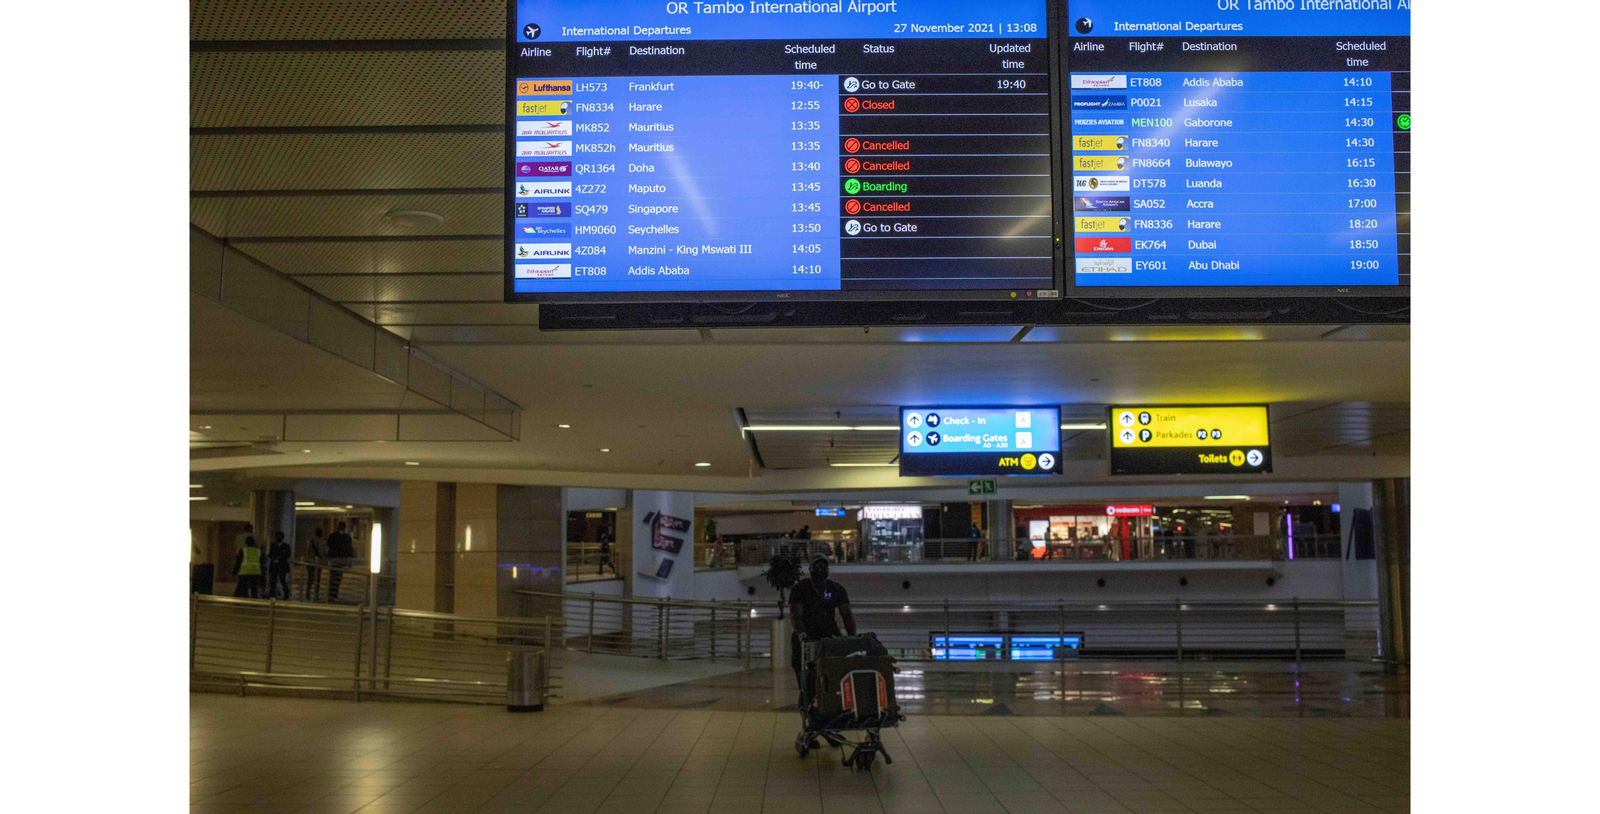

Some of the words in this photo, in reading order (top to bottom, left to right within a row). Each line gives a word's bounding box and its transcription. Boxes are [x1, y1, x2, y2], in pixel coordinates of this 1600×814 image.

[667, 2, 688, 14] OR
[694, 2, 744, 14] Tambo
[750, 2, 842, 13] International
[847, 1, 897, 15] Airport
[1217, 0, 1240, 10] OR
[1246, 0, 1295, 10] Tambo
[1300, 0, 1392, 10] International
[562, 26, 630, 36] International
[633, 25, 691, 36] Departures
[894, 24, 907, 33] 27
[911, 24, 965, 33] November
[968, 24, 994, 33] 2021
[1007, 24, 1037, 33] 13:08
[1114, 22, 1182, 31] International
[1185, 22, 1243, 32] Departures
[785, 44, 835, 54] Scheduled
[863, 44, 894, 53] Status
[989, 44, 1031, 54] Updated
[1074, 42, 1104, 51] Airline
[1129, 42, 1164, 52] Flight#
[1182, 42, 1237, 51] Destination
[1336, 41, 1386, 50] Scheduled
[521, 47, 551, 57] Airline
[576, 46, 611, 58] Flight#
[629, 46, 685, 55] Destination
[795, 60, 817, 70] time
[1002, 60, 1024, 68] time
[1347, 58, 1369, 66] time
[629, 81, 675, 91] Frankfurt
[791, 81, 824, 90] 19:40-
[862, 80, 876, 90] Go
[878, 80, 889, 89] to
[892, 80, 915, 89] Gate
[997, 80, 1026, 89] 19:40
[1130, 78, 1162, 87] ET808
[1182, 77, 1210, 87] Addis
[1212, 77, 1243, 87] Ababa
[1344, 78, 1372, 87] 14:10
[534, 84, 571, 92] Lufthansa
[576, 82, 608, 92] LH573
[576, 102, 614, 112] FN8334
[629, 102, 662, 112] Harare
[791, 101, 820, 110] 12:55
[862, 100, 895, 110] Closed
[1131, 98, 1161, 107] P0021
[1183, 98, 1217, 107] Lusaka
[1344, 98, 1373, 107] 14:15
[522, 103, 547, 115] fastjet
[629, 122, 674, 132] Mauritius
[791, 121, 820, 130] 13:35
[1132, 118, 1172, 127] MEN100
[1184, 118, 1233, 127] Gaborone
[1345, 118, 1373, 127] 14:30
[576, 123, 610, 132] MK852
[629, 142, 674, 152] Mauritius
[791, 142, 820, 151] 13:35
[862, 141, 910, 150] Cancelled
[1078, 137, 1103, 149] fastjet
[1132, 138, 1170, 148] FN8340
[1185, 138, 1218, 147] Harare
[1346, 138, 1375, 147] 14:30
[576, 143, 616, 153] MK852h
[791, 162, 820, 171] 13:40
[863, 161, 910, 171] Cancelled
[1079, 158, 1104, 170] fastjet
[1133, 159, 1171, 168] FN8664
[1185, 158, 1233, 170] Bulawayo
[1347, 159, 1375, 167] 16:15
[575, 163, 615, 174] QR1364
[628, 163, 655, 173] Doha
[791, 182, 820, 191] 13:45
[863, 181, 907, 193] Boarding
[1133, 179, 1166, 188] DT578
[1186, 178, 1222, 188] Luanda
[1347, 179, 1376, 188] 16:30
[575, 184, 606, 194] 4Z272
[628, 183, 666, 195] Maputo
[791, 203, 820, 212] 13:45
[863, 202, 910, 212] Cancelled
[1133, 199, 1165, 209] SA052
[1186, 199, 1214, 208] Accra
[1348, 199, 1377, 208] 17:00
[575, 204, 608, 216] SQ479
[628, 204, 678, 216] Singapore
[792, 224, 821, 233] 13:50
[863, 223, 878, 232] Go
[880, 224, 891, 232] to
[894, 223, 917, 232] Gate
[1080, 219, 1105, 232] fastjet
[1134, 220, 1173, 229] FN8336
[1187, 220, 1221, 229] Harare
[1349, 220, 1378, 229] 18:20
[575, 225, 616, 235] HM9060
[628, 224, 679, 236] Seychelles
[792, 244, 821, 253] 14:05
[1135, 240, 1167, 250] EK764
[1188, 240, 1217, 250] Dubai
[1349, 240, 1379, 249] 18:50
[575, 246, 606, 255] 4Z084
[628, 244, 666, 254] Manzini
[676, 244, 698, 257] King
[702, 244, 737, 254] Mswati
[740, 244, 752, 254] III
[792, 265, 821, 274] 14:10
[1135, 261, 1167, 270] EY601
[1188, 260, 1208, 270] Abu
[1211, 260, 1240, 270] Dhabi
[1350, 261, 1379, 270] 19:00
[575, 266, 606, 276] ET808
[628, 266, 655, 276] Addis
[658, 266, 690, 275] Ababa
[943, 434, 981, 444] Boarding
[982, 434, 1008, 442] Gates
[998, 458, 1018, 466] ATM
[1198, 454, 1228, 463] Toilets
